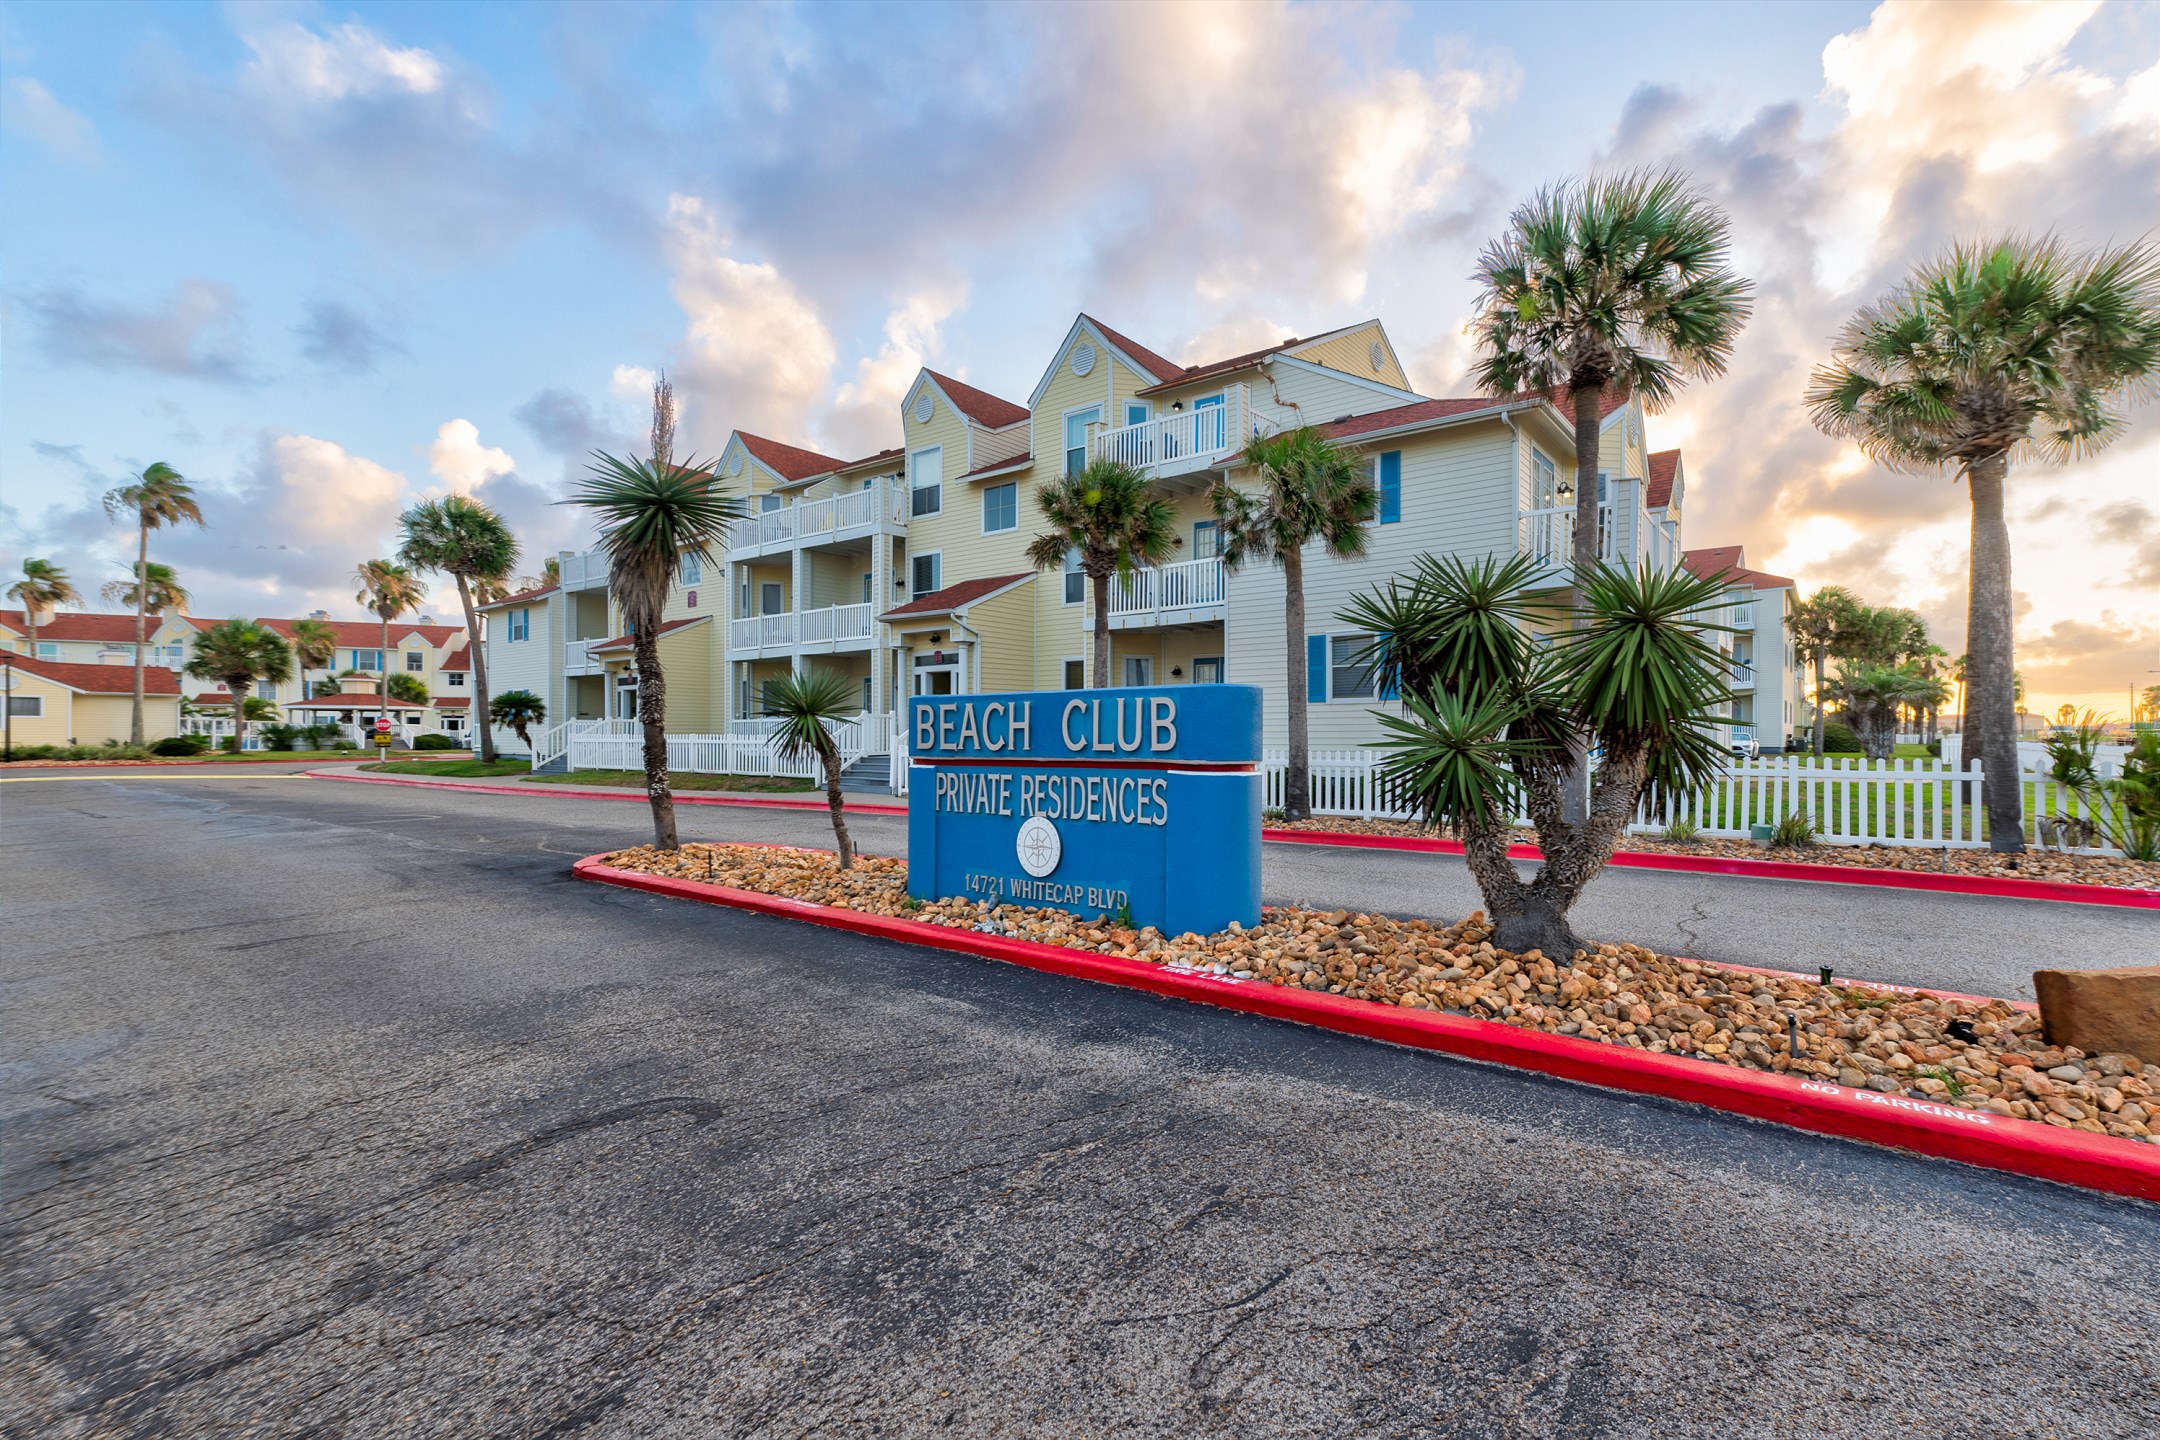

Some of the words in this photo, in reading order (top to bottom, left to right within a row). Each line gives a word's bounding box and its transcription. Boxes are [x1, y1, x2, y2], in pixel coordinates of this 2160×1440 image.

[916, 701, 1031, 751] BEACH
[1062, 697, 1177, 753] CLUB
[935, 772, 1013, 816] PRIVATE
[1020, 775, 1168, 826] RESIDENCES
[965, 873, 1004, 895] 14721
[1010, 878, 1084, 905] WHITECAP
[1088, 887, 1128, 910] BLVD
[1197, 973, 1245, 984] LANE
[1801, 1082, 1840, 1095] NO
[1855, 1091, 1991, 1125] PARKING
